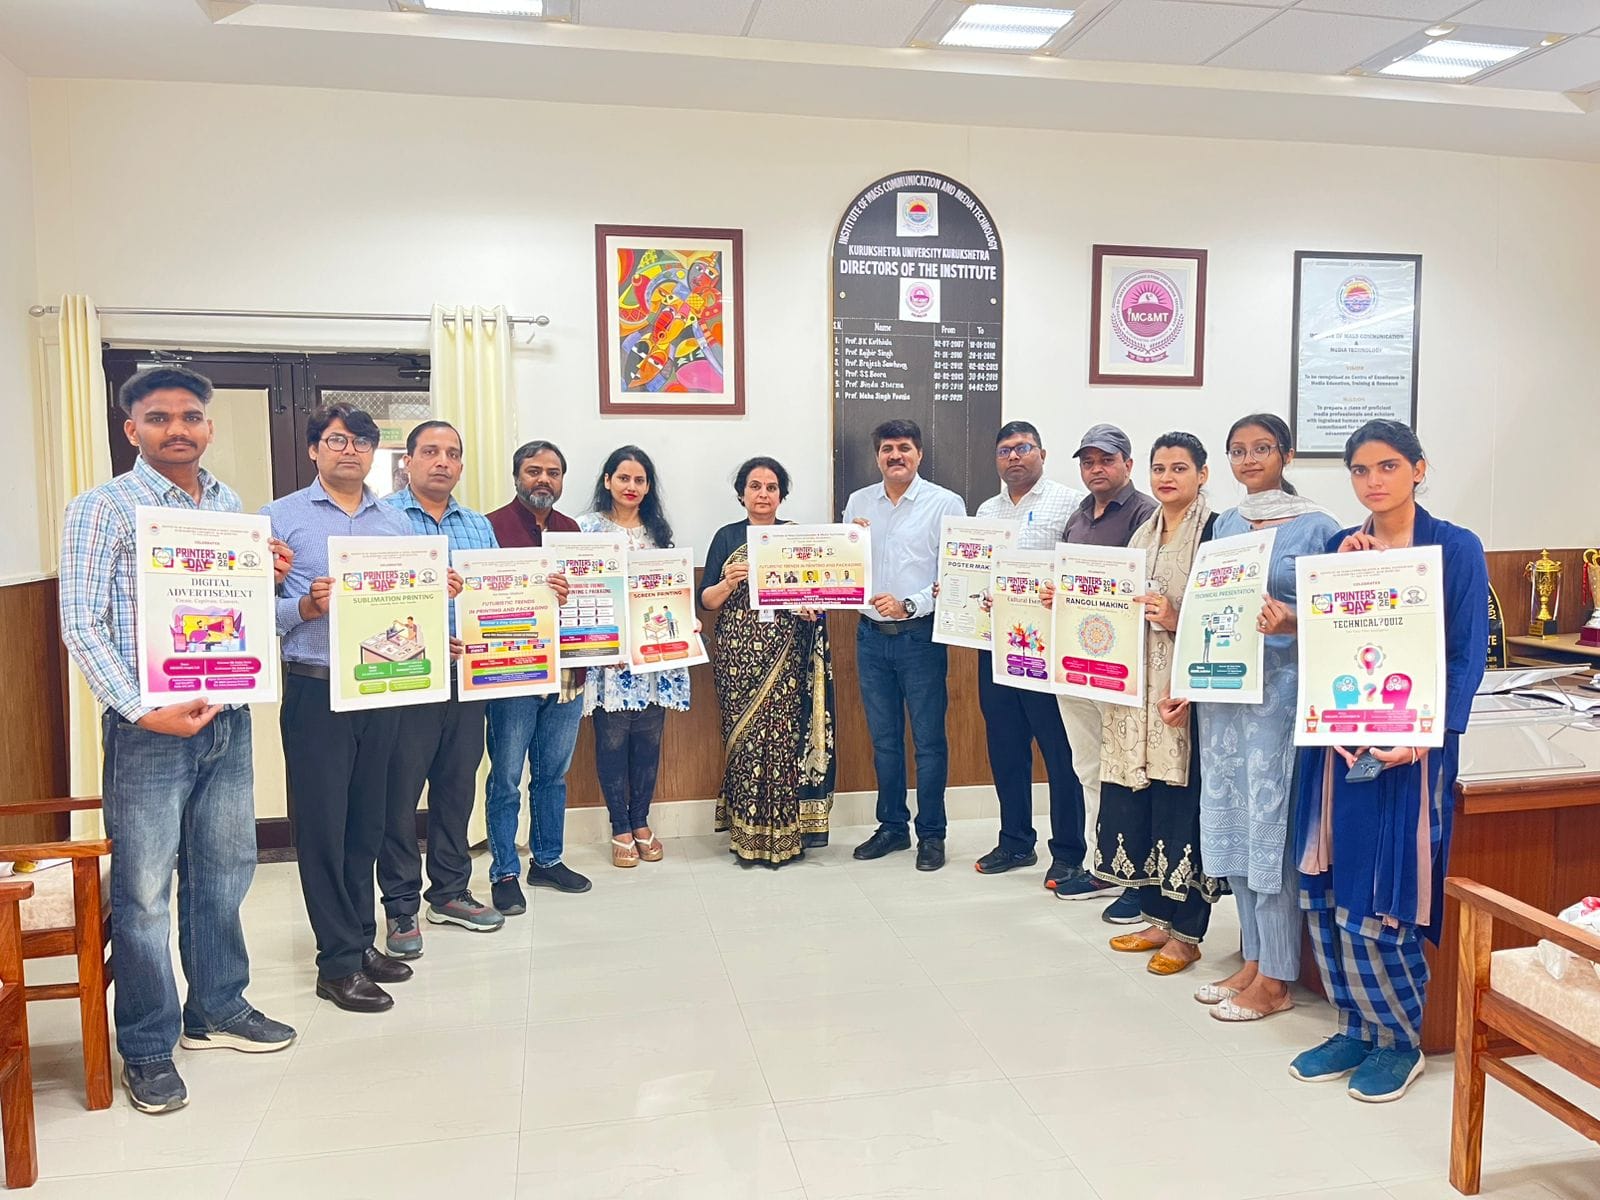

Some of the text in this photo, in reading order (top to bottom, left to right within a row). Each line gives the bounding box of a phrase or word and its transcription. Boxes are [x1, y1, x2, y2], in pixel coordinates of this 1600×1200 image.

[838, 205, 863, 245] INSTITUTE
[858, 197, 868, 210] OF
[864, 184, 884, 204] MASS
[882, 174, 942, 192] COMMUNICATION
[940, 182, 956, 196] AND
[954, 188, 976, 210] MEDIA
[972, 205, 998, 250] TECHNOLOGY
[848, 244, 990, 261] KURUKSHETRA UNIVERSITY KURUKSHETRA
[840, 259, 996, 280] DIRECTORS OF THE INSTITUTE
[874, 322, 892, 332] Name
[942, 325, 956, 334] From
[976, 326, 984, 334] To
[878, 349, 894, 359] Singh
[959, 542, 981, 550] PRINTERS
[176, 548, 216, 559] PRINTERS
[187, 559, 209, 572] DAY
[573, 566, 587, 576] DAY
[363, 570, 399, 580] PRINTERS
[1209, 566, 1233, 577] PRINTERS
[191, 578, 232, 587] DIGITAL
[1007, 577, 1028, 585] PRINTERS
[1075, 575, 1102, 585] PRINTERS
[373, 580, 392, 592] DAY
[1082, 584, 1099, 595] DAY
[166, 588, 254, 598] ADVERTISEMENT
[1334, 589, 1376, 602] PRINTERS
[353, 595, 401, 604] SUBLIMATION
[1066, 598, 1129, 610] RANGOLI MAKING
[1346, 600, 1370, 615] DAY
